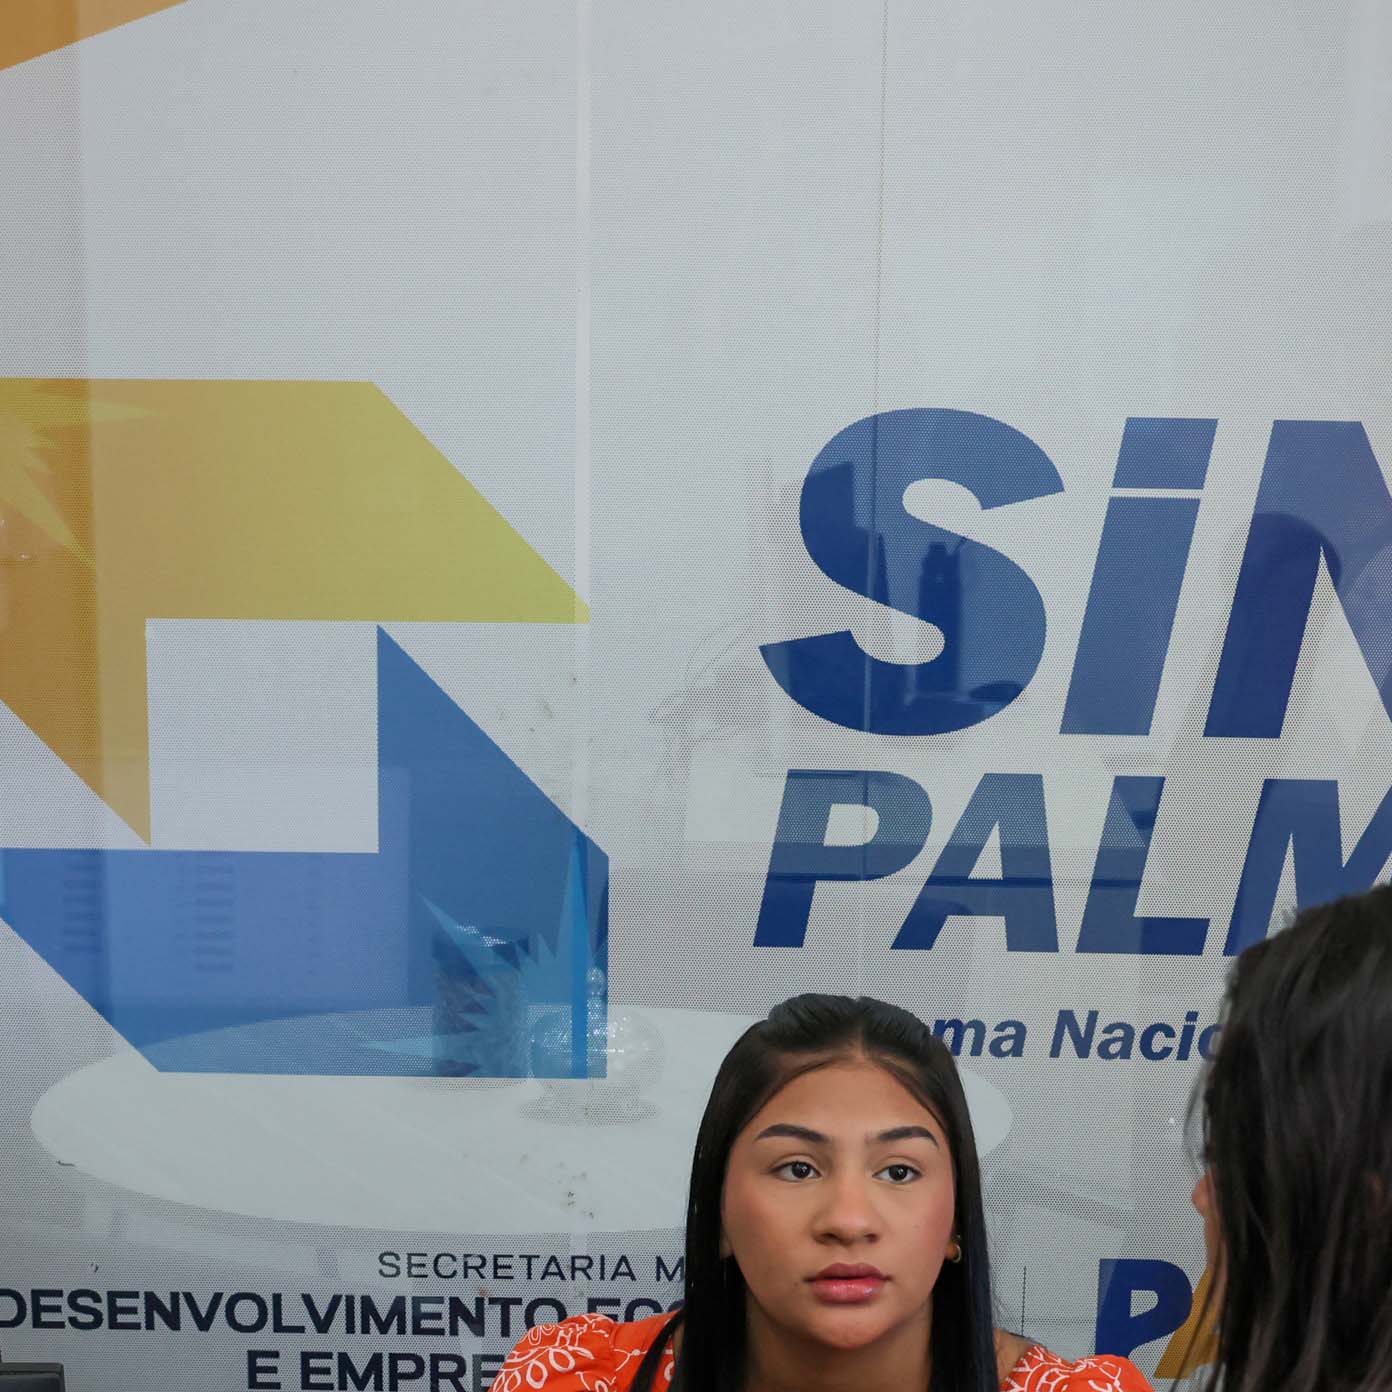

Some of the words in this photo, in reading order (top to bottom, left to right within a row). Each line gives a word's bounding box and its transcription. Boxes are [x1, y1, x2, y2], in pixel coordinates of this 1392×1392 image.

[1049, 1009, 1226, 1062] Nacio
[378, 1251, 637, 1282] SECRETARIA
[246, 1349, 282, 1391] E
